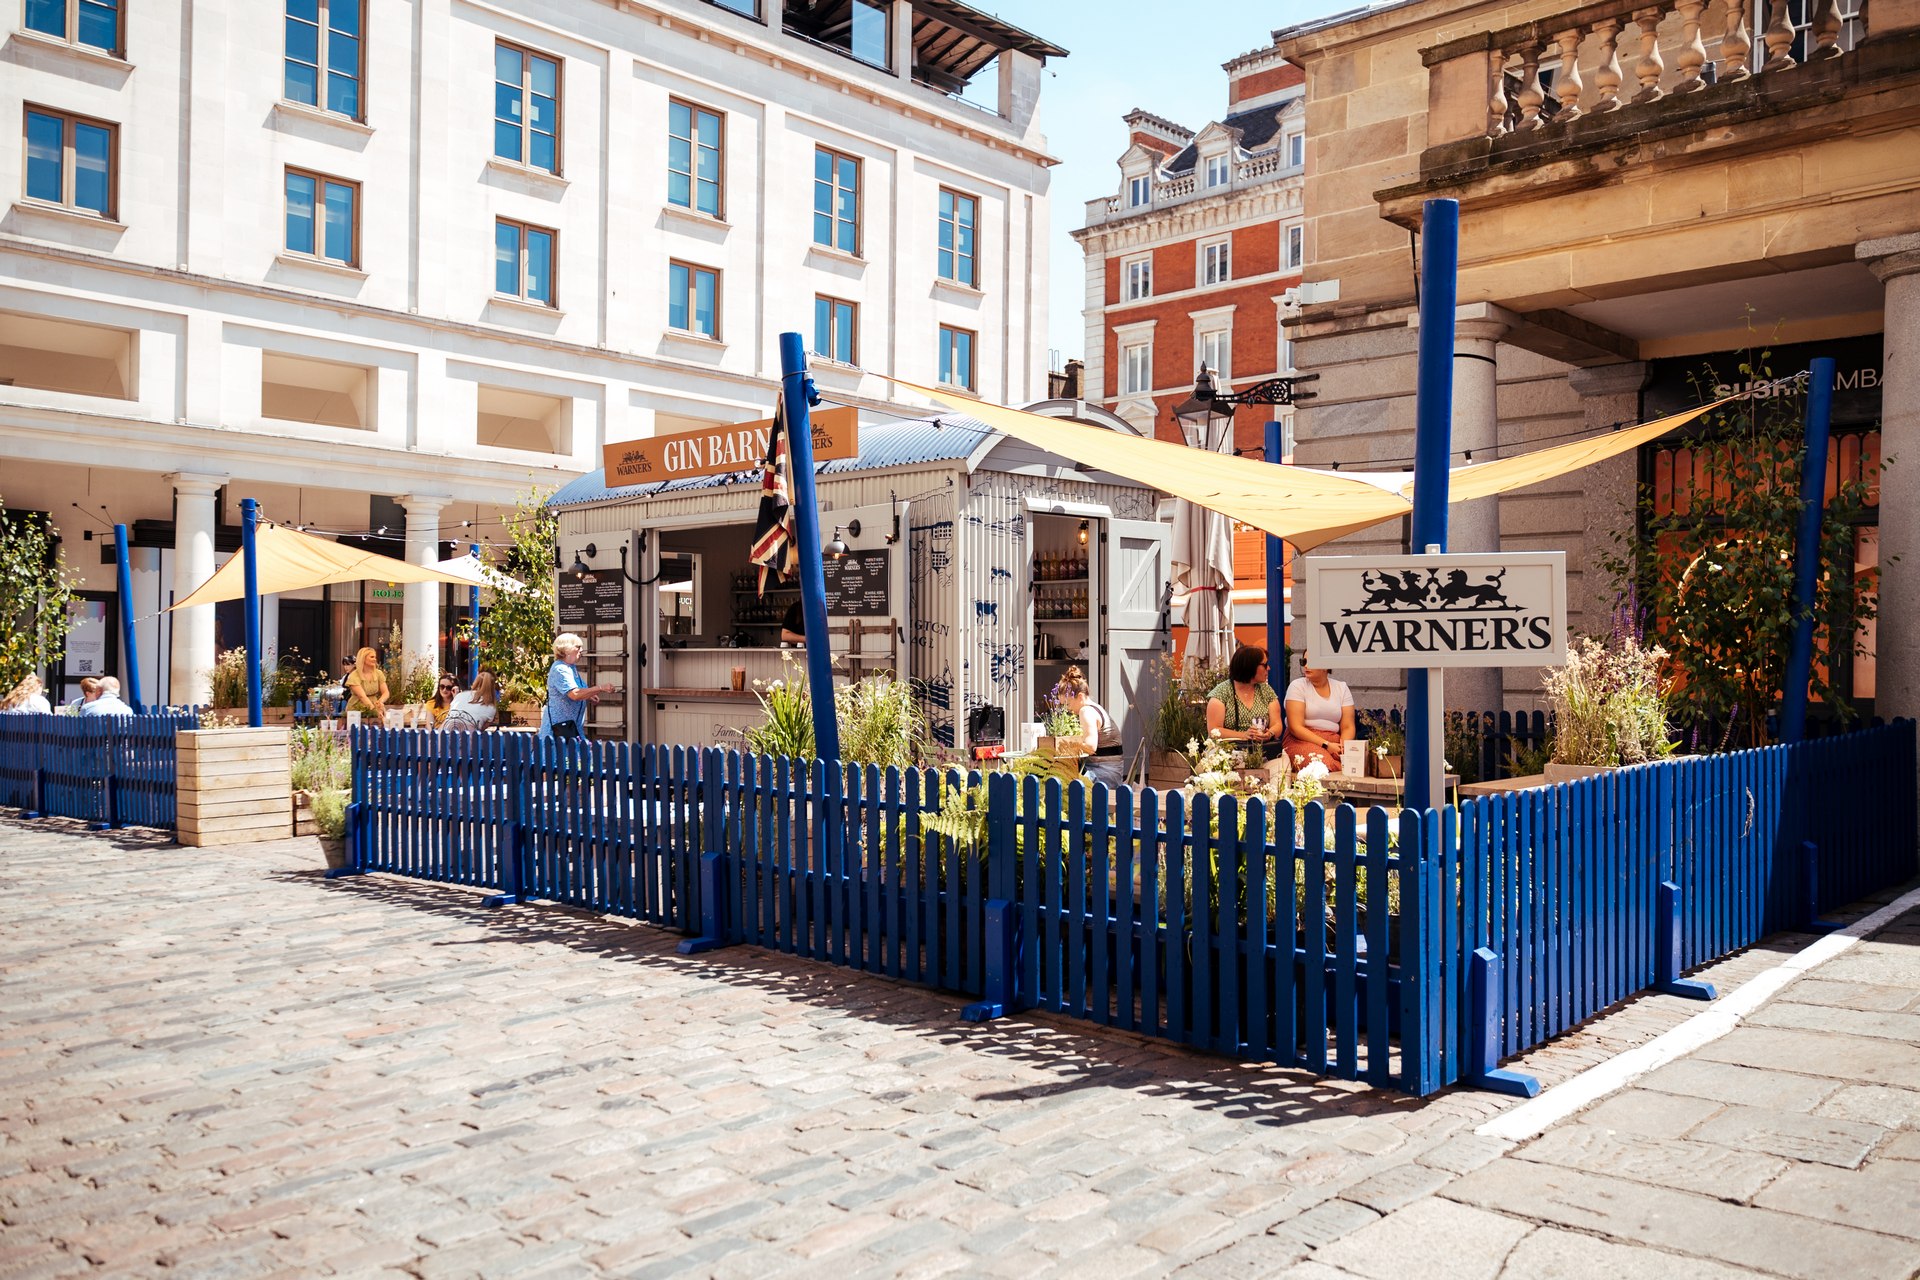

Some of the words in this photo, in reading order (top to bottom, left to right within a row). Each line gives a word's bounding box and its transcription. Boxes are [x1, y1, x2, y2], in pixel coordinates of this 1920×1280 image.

[663, 437, 703, 472] GIN
[707, 427, 772, 466] BARN
[616, 462, 652, 476] WARNER'S
[1320, 616, 1551, 653] WARNER'S
